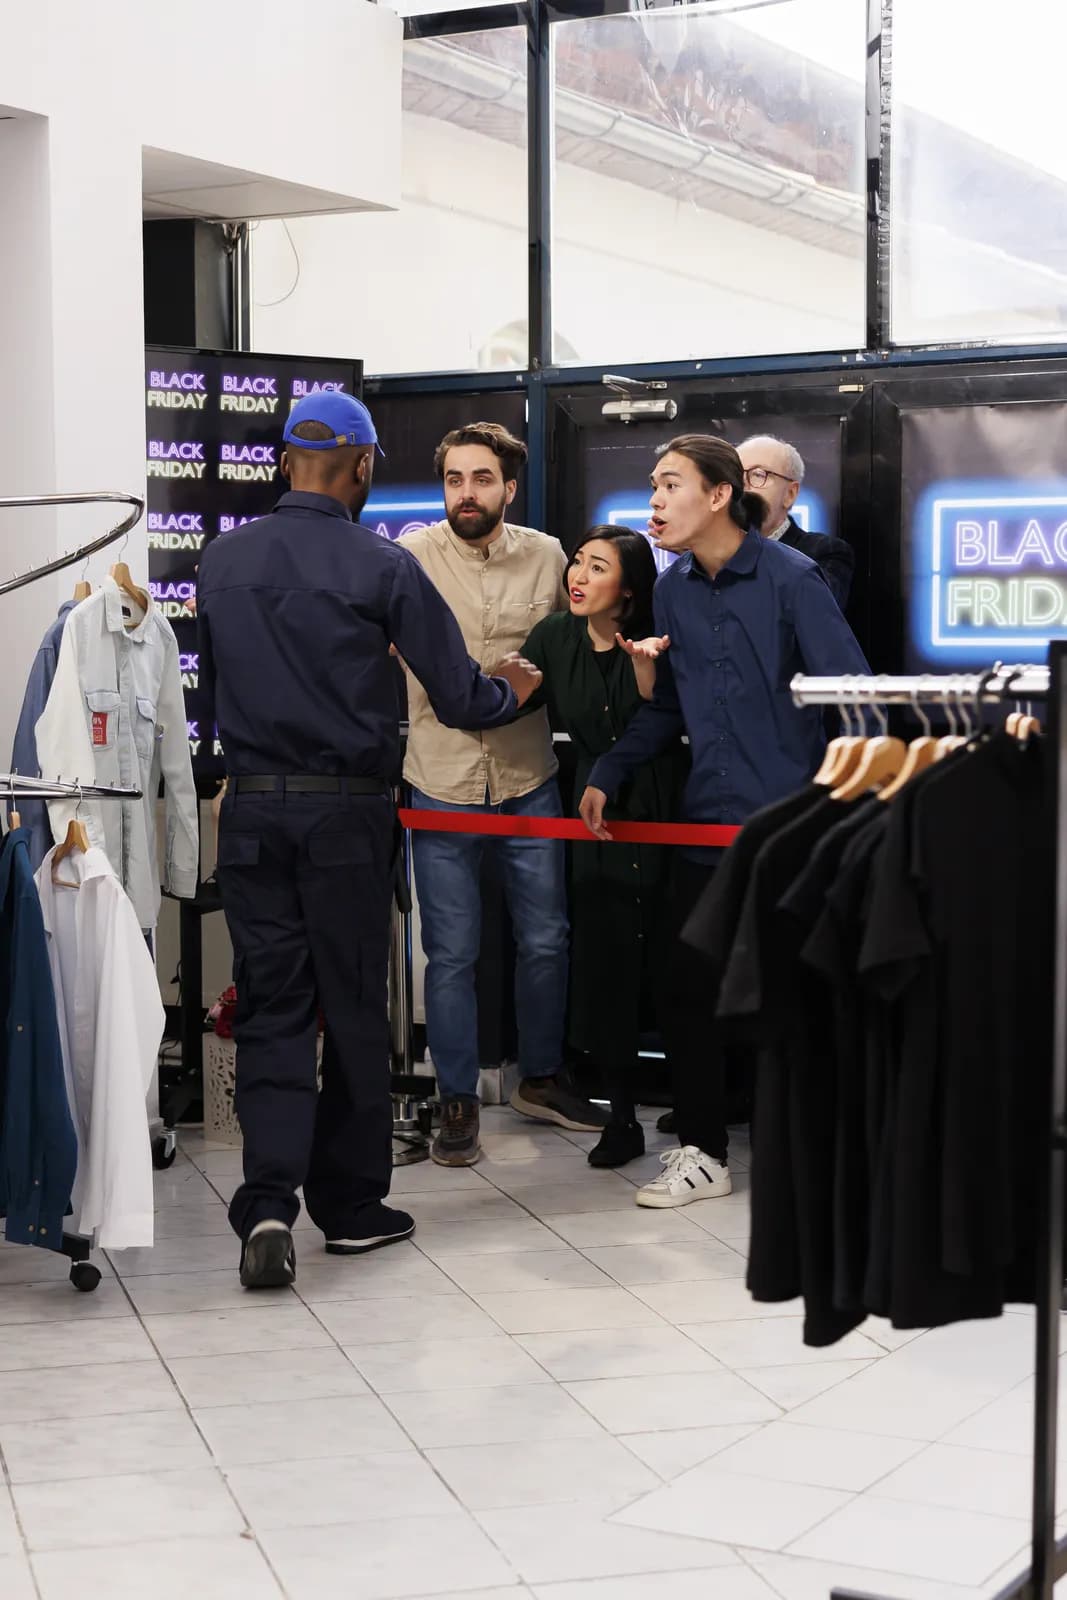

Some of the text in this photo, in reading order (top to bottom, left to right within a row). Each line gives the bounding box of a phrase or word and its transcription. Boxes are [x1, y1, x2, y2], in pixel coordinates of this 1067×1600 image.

[150, 371, 206, 390] BLACK
[223, 376, 276, 394] BLACK
[147, 390, 208, 410] FRIDAY
[220, 395, 278, 413] FRIDAY
[149, 441, 204, 460] BLACK
[222, 445, 275, 463] BLACK
[147, 460, 206, 479] FRIDAY
[219, 464, 277, 481] FRIDAY
[148, 513, 203, 531] BLACK
[147, 532, 205, 550] FRIDAY
[947, 579, 1067, 627] FRID
